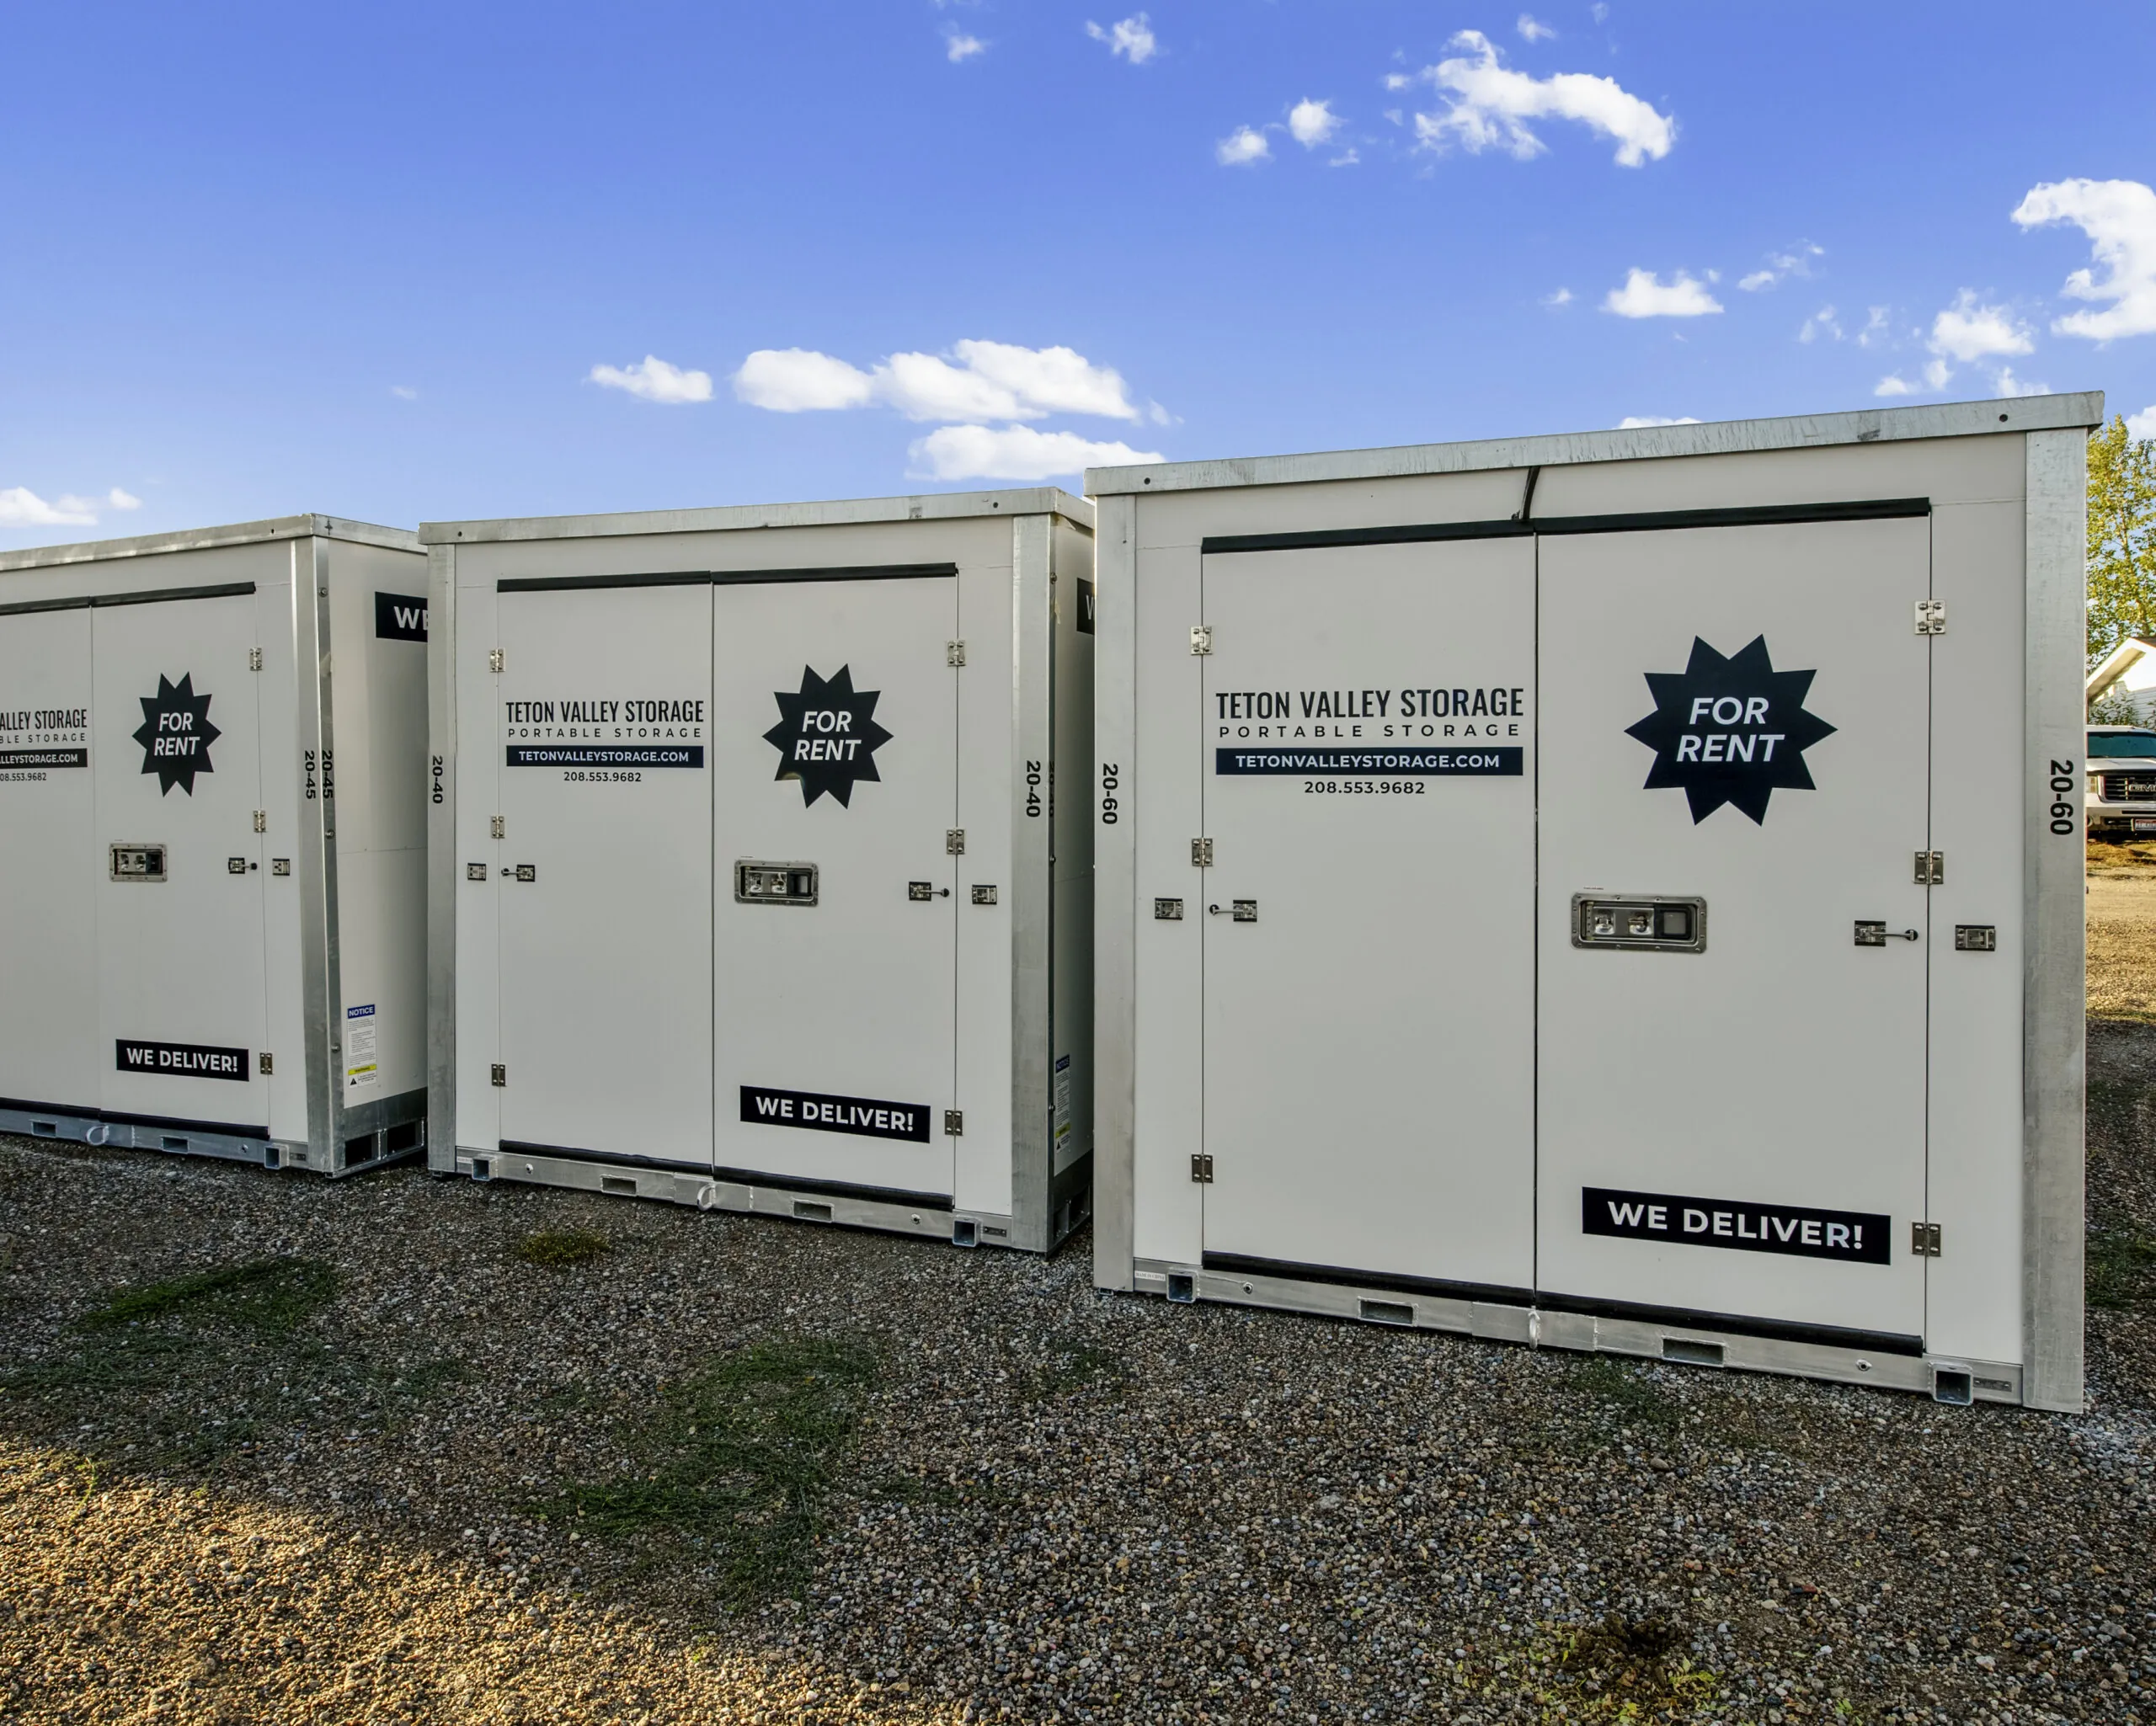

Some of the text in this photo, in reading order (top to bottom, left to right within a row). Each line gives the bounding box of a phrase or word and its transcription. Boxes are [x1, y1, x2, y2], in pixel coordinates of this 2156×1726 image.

[505, 700, 704, 723] TETON VALLEY STORAGE
[1216, 688, 1524, 720] TETON VALLEY STORAGE
[1689, 696, 1769, 725] FOR
[35, 709, 88, 730] STORAGE
[158, 712, 194, 732] FOR
[802, 711, 852, 732] FOR
[1219, 723, 1519, 738] PORTABLE STORAGE
[28, 732, 86, 743] STORAGE
[508, 727, 701, 738] PORTABLE STORAGE
[153, 736, 200, 756] RENT
[518, 751, 689, 763] TETONVALLEYSTORAGE.COM
[794, 739, 862, 761] RENT
[1676, 733, 1785, 762] RENT
[0, 754, 78, 765] LLEYSTORAGE.COM
[1235, 754, 1500, 769] TETONVALLEYSTORAGE.COM
[304, 750, 317, 799] 20-45
[321, 750, 334, 799] 20-45
[432, 755, 444, 804] 20-40
[563, 771, 642, 782] 208.553.9682
[1026, 760, 1041, 818] 20-40
[1102, 763, 1118, 825] 20-60
[1304, 780, 1425, 795] 208.553.9682
[2050, 759, 2074, 836] 20-60
[349, 1006, 374, 1017] NOTICE
[126, 1047, 238, 1073] WE DELIVER!
[755, 1096, 914, 1132] WE DELIVER!
[1607, 1201, 1863, 1249] WE DELIVER!
